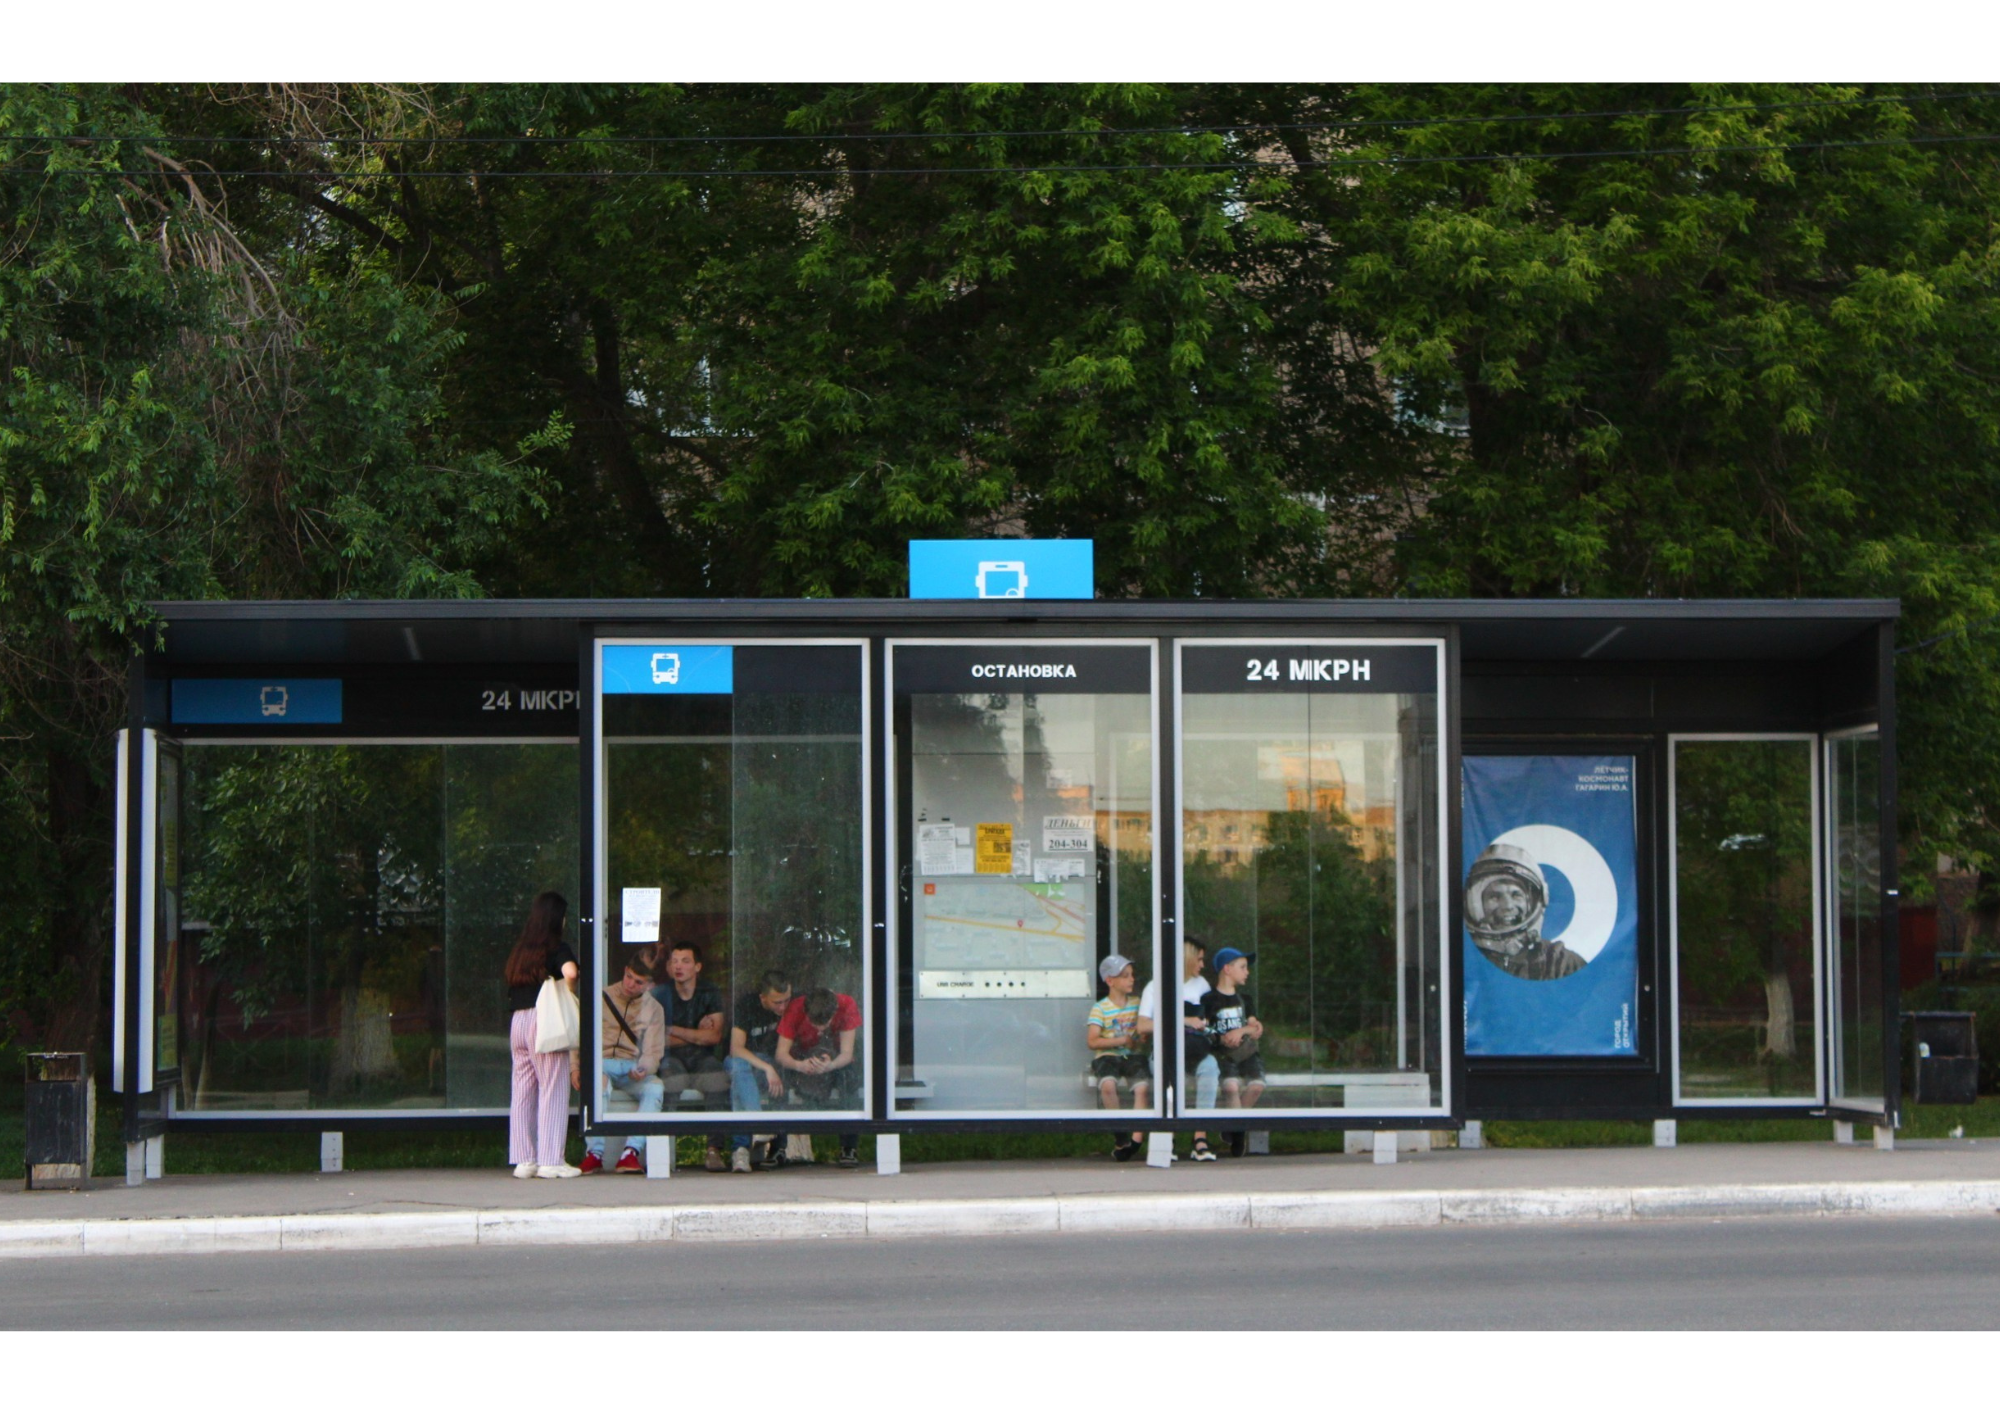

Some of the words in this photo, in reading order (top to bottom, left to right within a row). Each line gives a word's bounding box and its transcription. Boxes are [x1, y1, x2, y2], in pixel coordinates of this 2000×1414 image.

[971, 664, 1077, 678] ОСТАНОВКА
[1246, 659, 1279, 680] 24
[1289, 659, 1370, 680] МКРН
[482, 690, 511, 710] 24
[1578, 774, 1629, 782] КОСМОНАВТ
[1575, 783, 1610, 792] ГАГАРИН
[1049, 839, 1088, 849] 204-304
